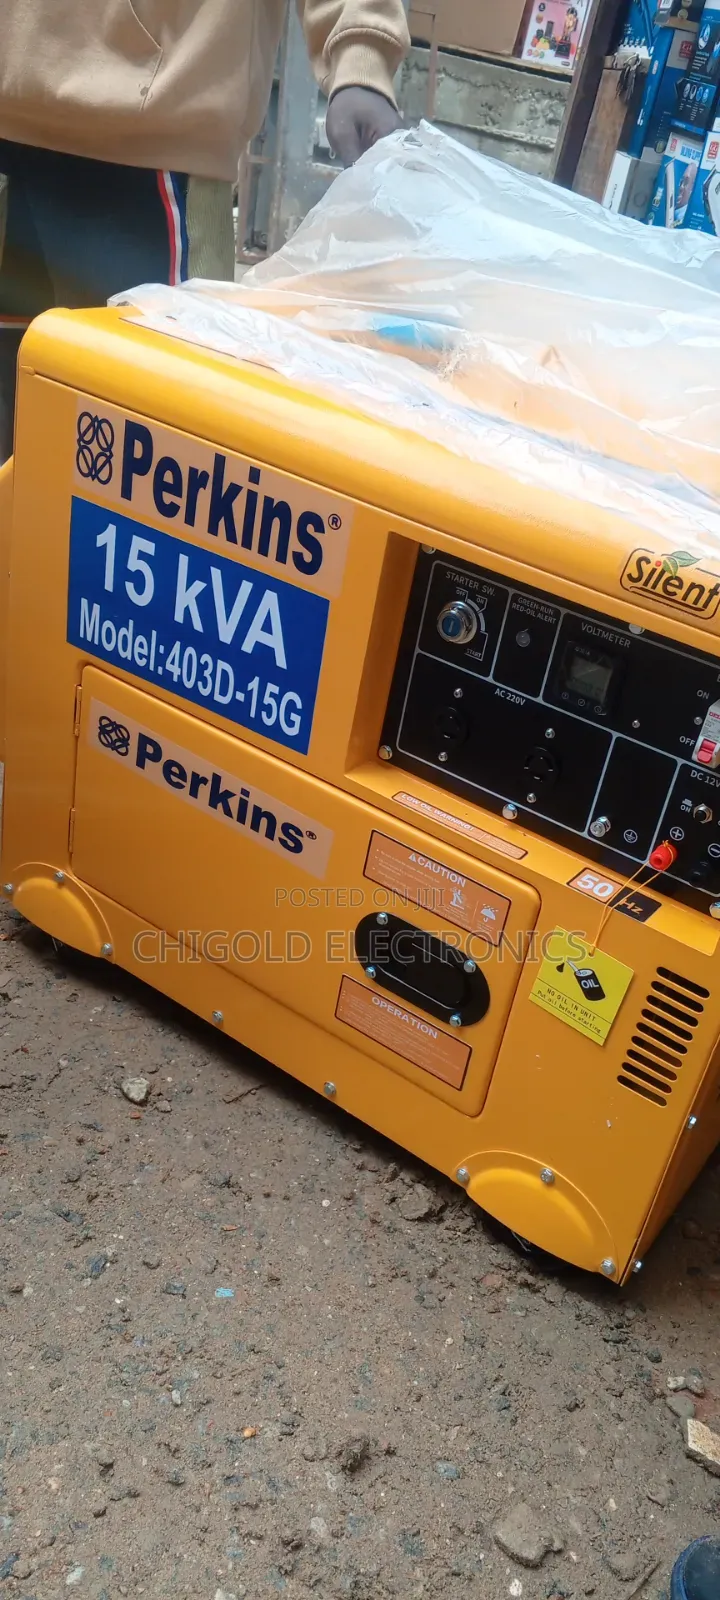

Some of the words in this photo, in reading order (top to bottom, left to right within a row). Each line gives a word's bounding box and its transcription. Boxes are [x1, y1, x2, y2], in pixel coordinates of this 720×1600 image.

[446, 571, 479, 589] STARTER
[481, 585, 496, 597] SW.
[626, 556, 720, 609] Silent
[96, 523, 156, 607] 15
[174, 553, 287, 670] kVA
[455, 589, 466, 597] OFF
[476, 597, 485, 605] ON
[512, 603, 536, 617] RED-OIL
[536, 614, 557, 625] ALERT
[517, 597, 554, 614] GREEN-RUN
[581, 622, 631, 648] VOLTMETER
[466, 648, 482, 657] START
[79, 597, 303, 737] Model:403D-15G
[494, 688, 506, 698] AC
[506, 692, 526, 706] 220V
[696, 689, 710, 700] ON
[679, 735, 696, 747] OFF
[690, 769, 703, 781] DC
[402, 793, 420, 805] LOW
[680, 804, 692, 813] ON
[417, 857, 467, 888] CAUTION
[576, 873, 615, 897] 50
[581, 979, 600, 988] OIL
[547, 988, 555, 997] NO
[557, 993, 568, 1005] OIL
[571, 1003, 579, 1011] IN
[580, 1009, 597, 1021] UNIT
[371, 996, 438, 1039] OPERATION
[577, 1016, 602, 1034] starting
